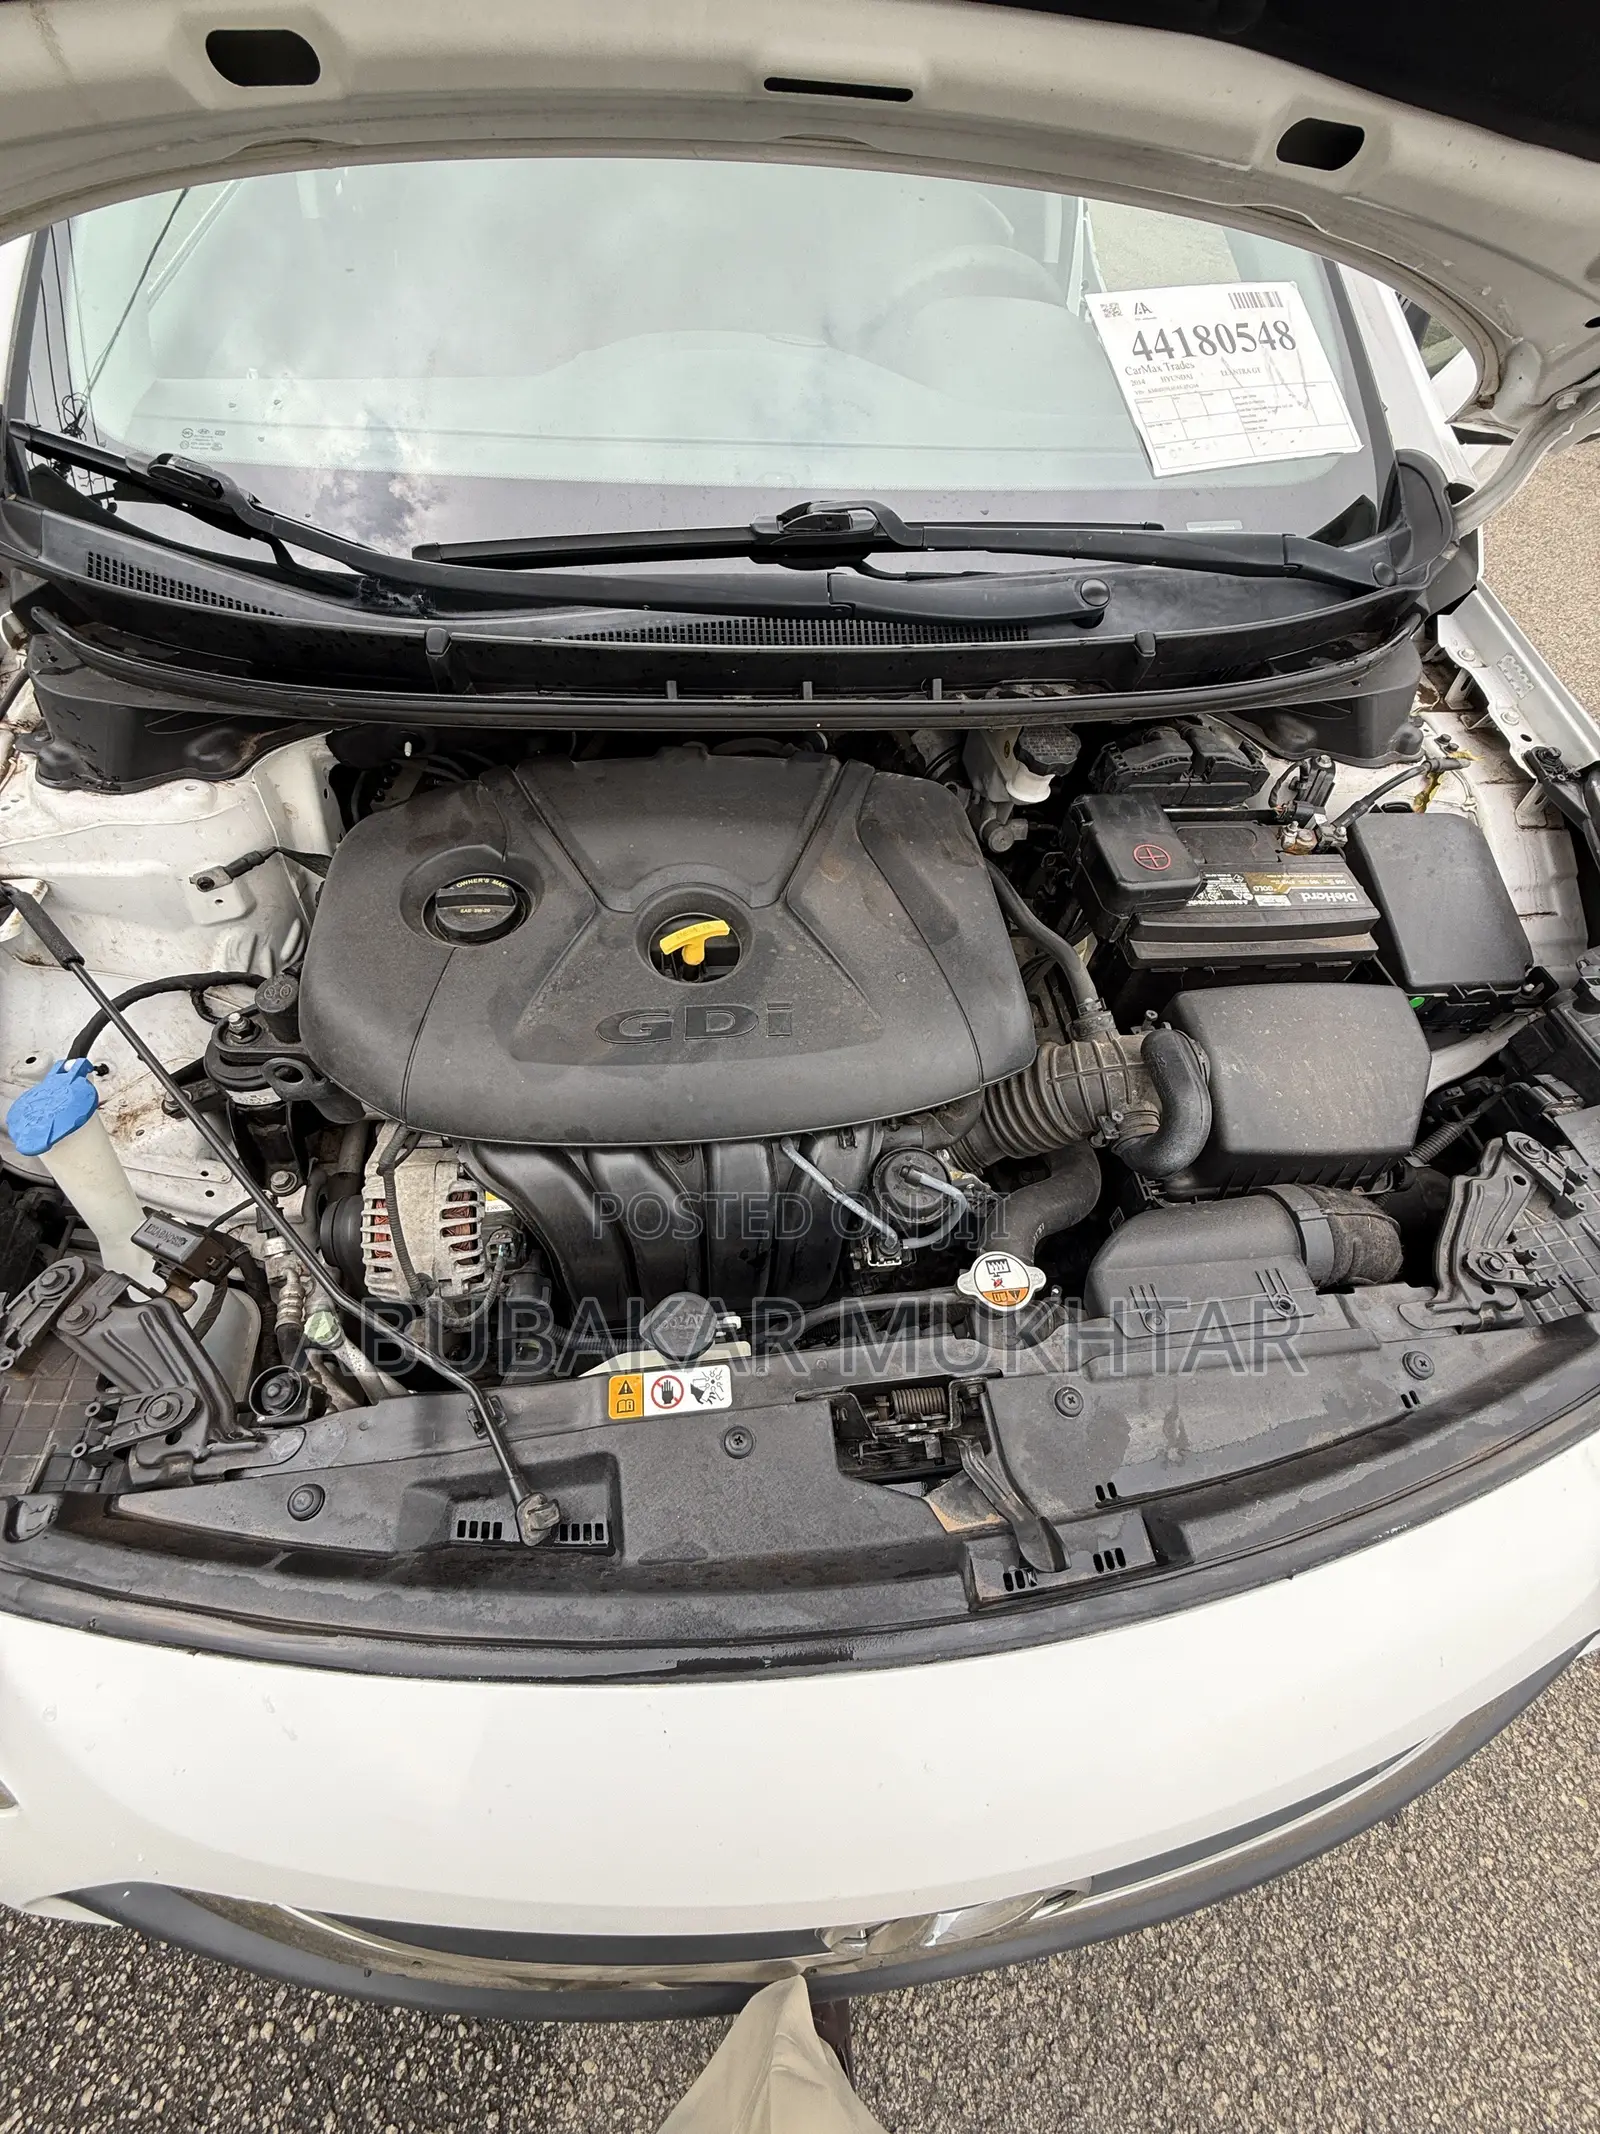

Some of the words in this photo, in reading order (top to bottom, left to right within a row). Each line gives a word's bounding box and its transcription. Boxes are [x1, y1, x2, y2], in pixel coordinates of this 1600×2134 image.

[1132, 320, 1297, 362] 44180548
[1124, 364, 1162, 376] CarMax
[1163, 360, 1196, 372] Trades
[1130, 379, 1146, 387] 2014
[1160, 373, 1194, 383] HYUNDAI
[456, 878, 490, 888] OWNER'S
[1300, 892, 1359, 903] DieHard
[595, 1001, 793, 1045] GDi
